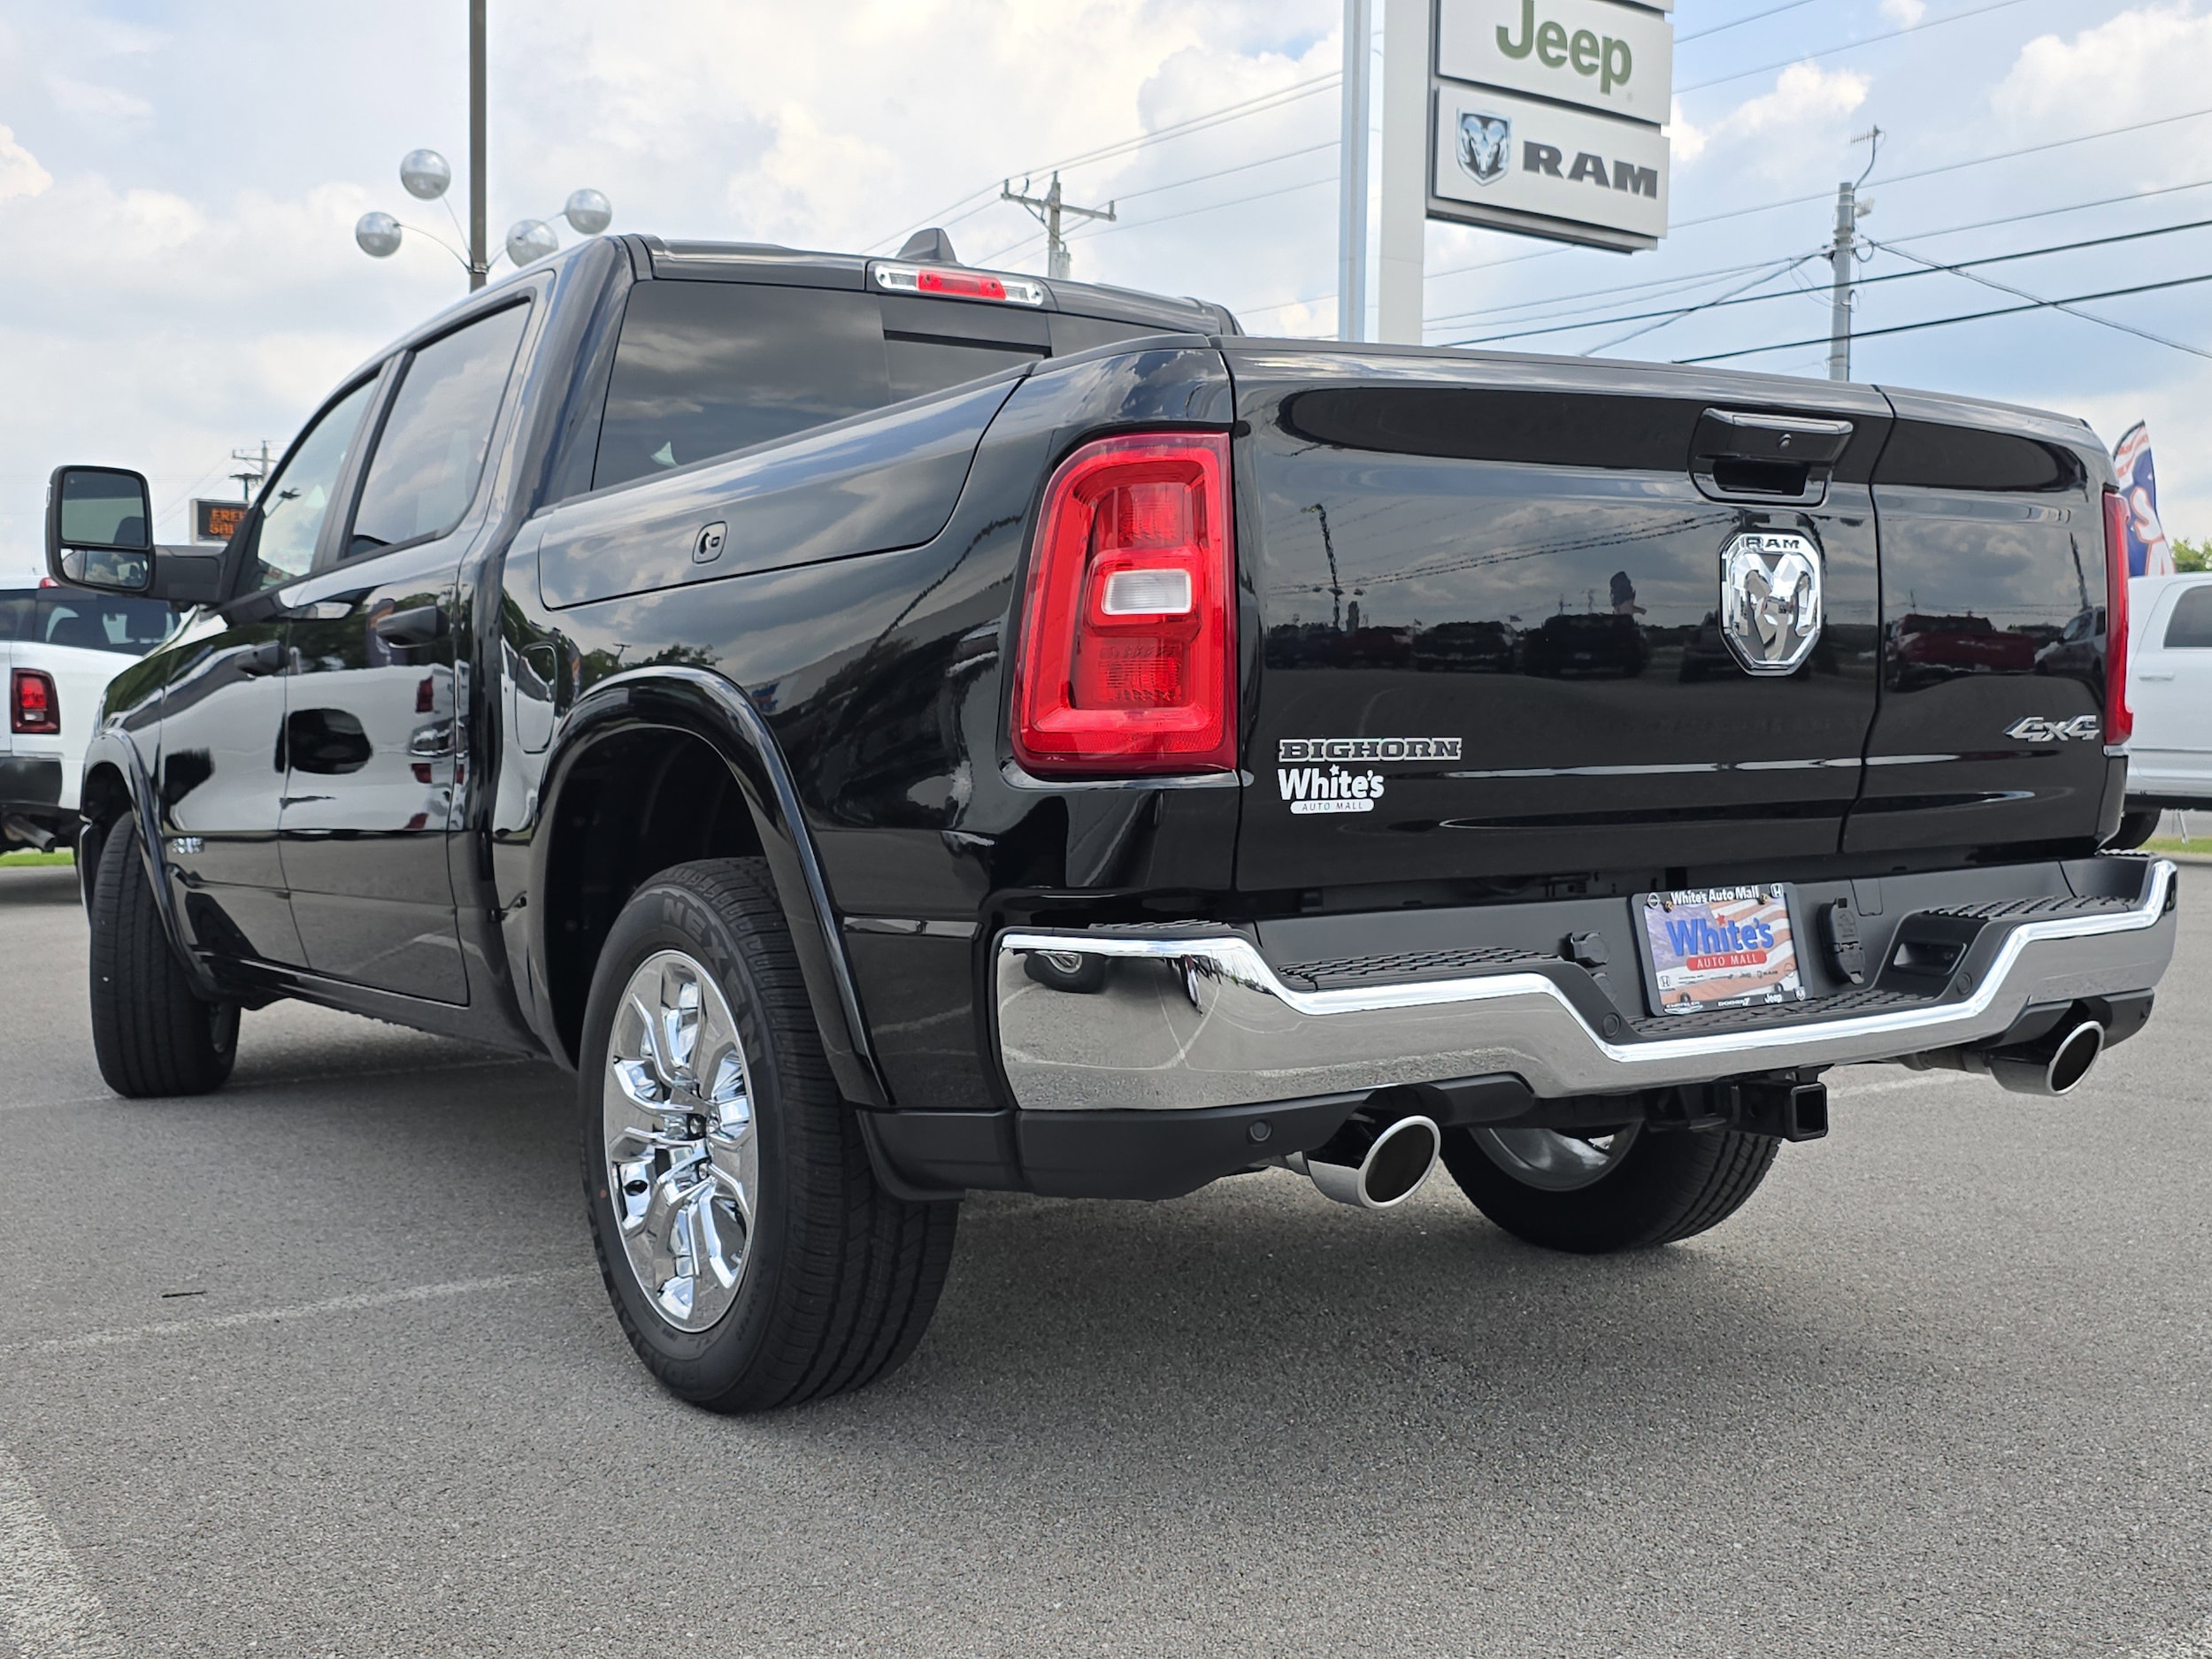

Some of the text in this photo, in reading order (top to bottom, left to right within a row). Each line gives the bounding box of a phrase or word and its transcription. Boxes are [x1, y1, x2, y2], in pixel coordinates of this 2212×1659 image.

[1496, 0, 1632, 96] Jeep
[1522, 141, 1658, 200] RAM
[1745, 537, 1800, 549] RAM
[1279, 738, 1463, 763] BIGHORN
[1278, 764, 1385, 801] White's
[1302, 801, 1363, 811] AUTO MALL
[1670, 885, 1760, 906] White's Auto Mall
[1665, 913, 1775, 956] White's
[1696, 953, 1757, 970] AUTO MALL
